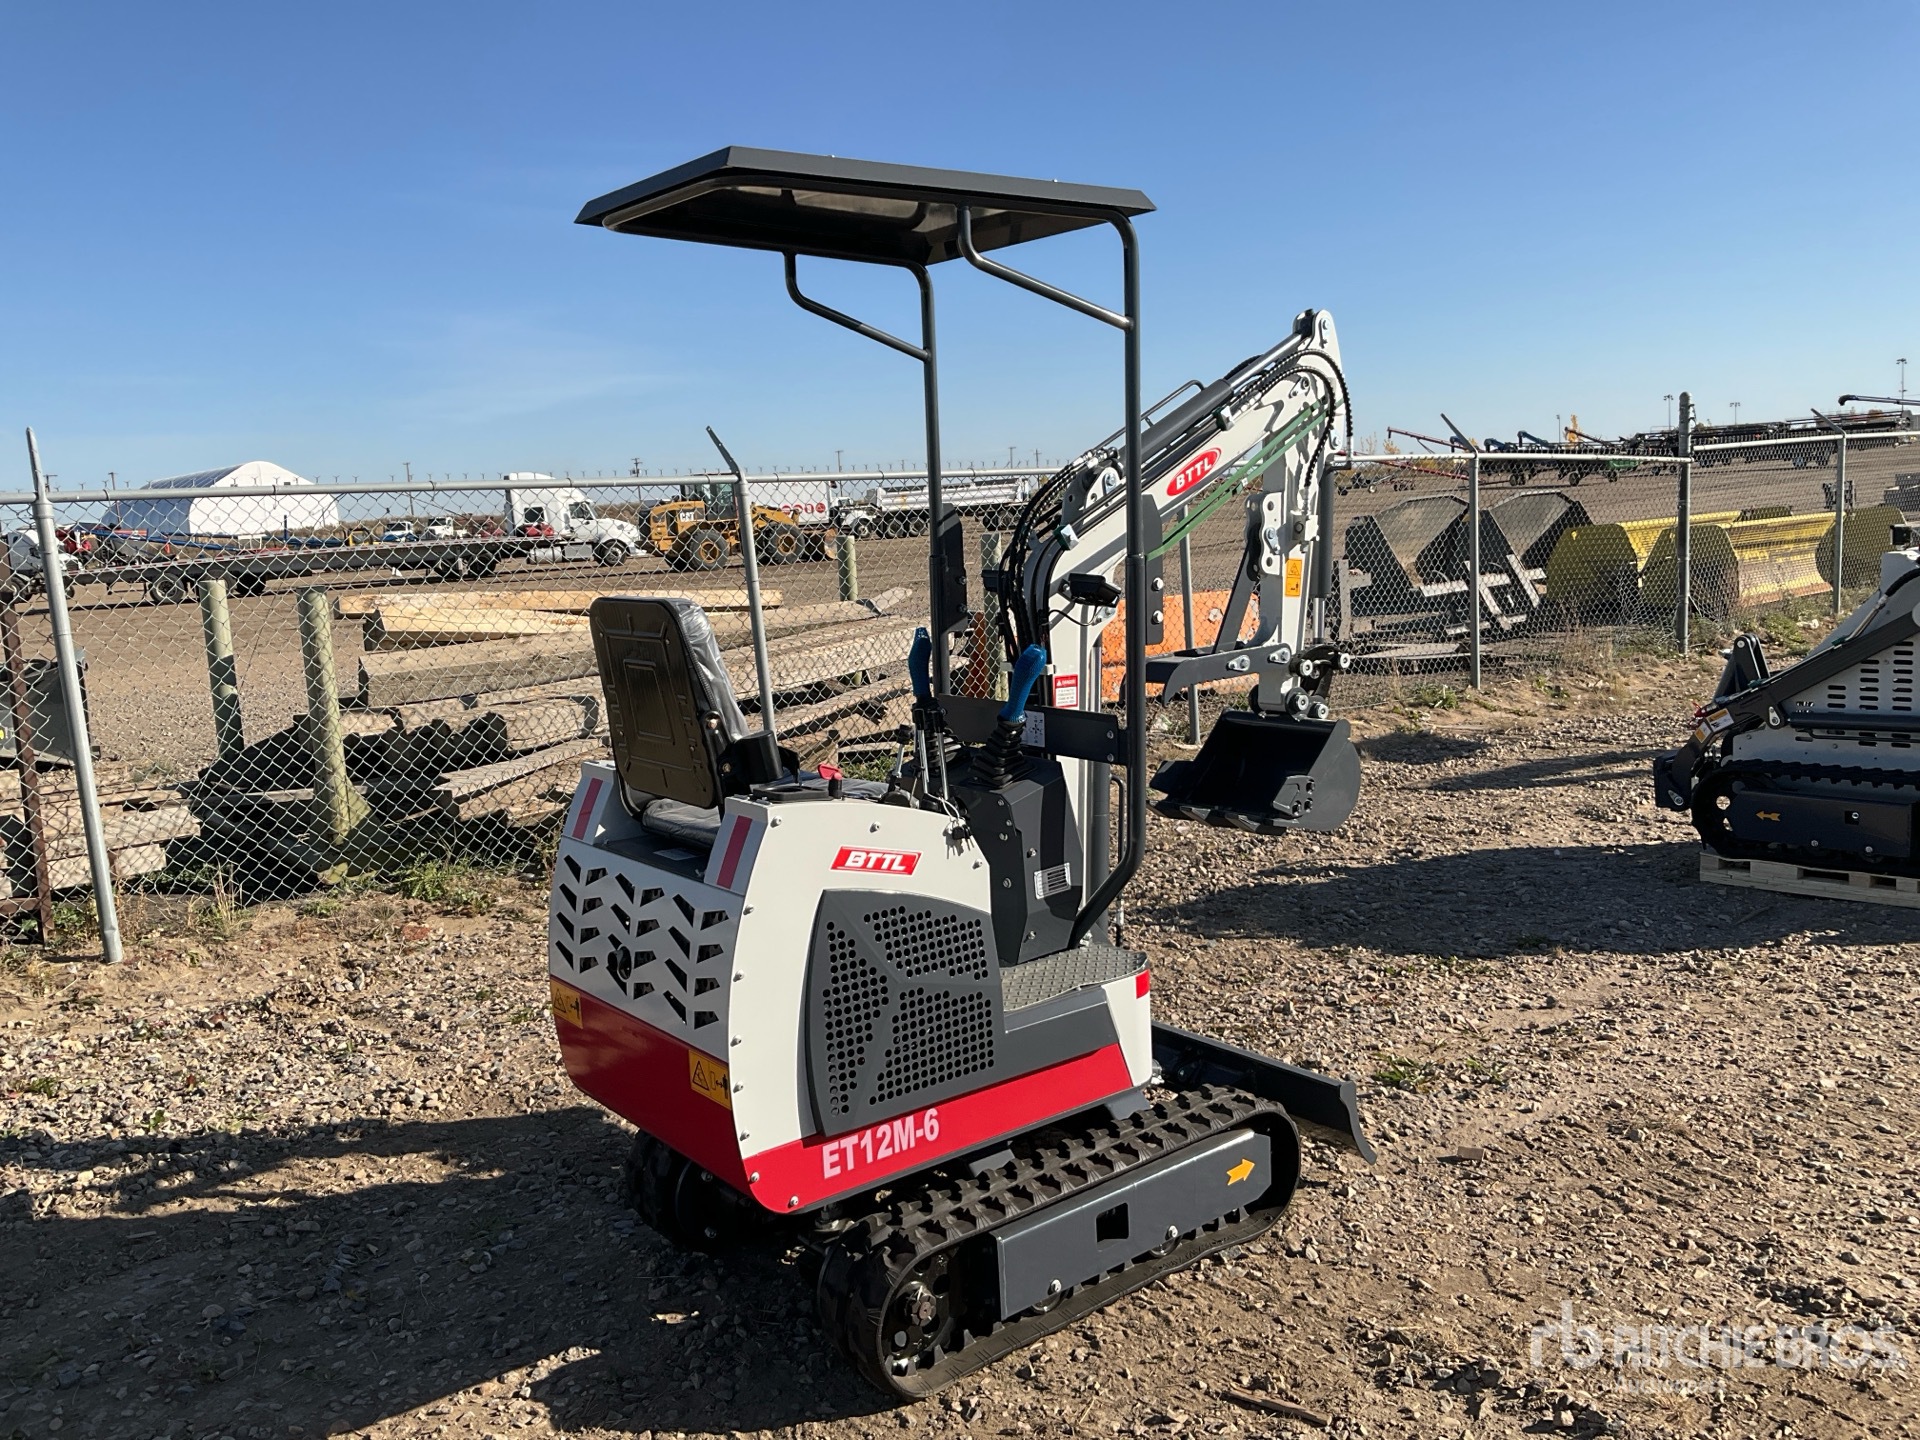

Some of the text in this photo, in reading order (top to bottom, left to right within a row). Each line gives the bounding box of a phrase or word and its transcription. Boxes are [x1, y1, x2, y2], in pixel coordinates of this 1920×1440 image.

[1175, 457, 1212, 490] BTTL
[844, 851, 907, 871] BTTL
[822, 1108, 940, 1179] ET12M-6
